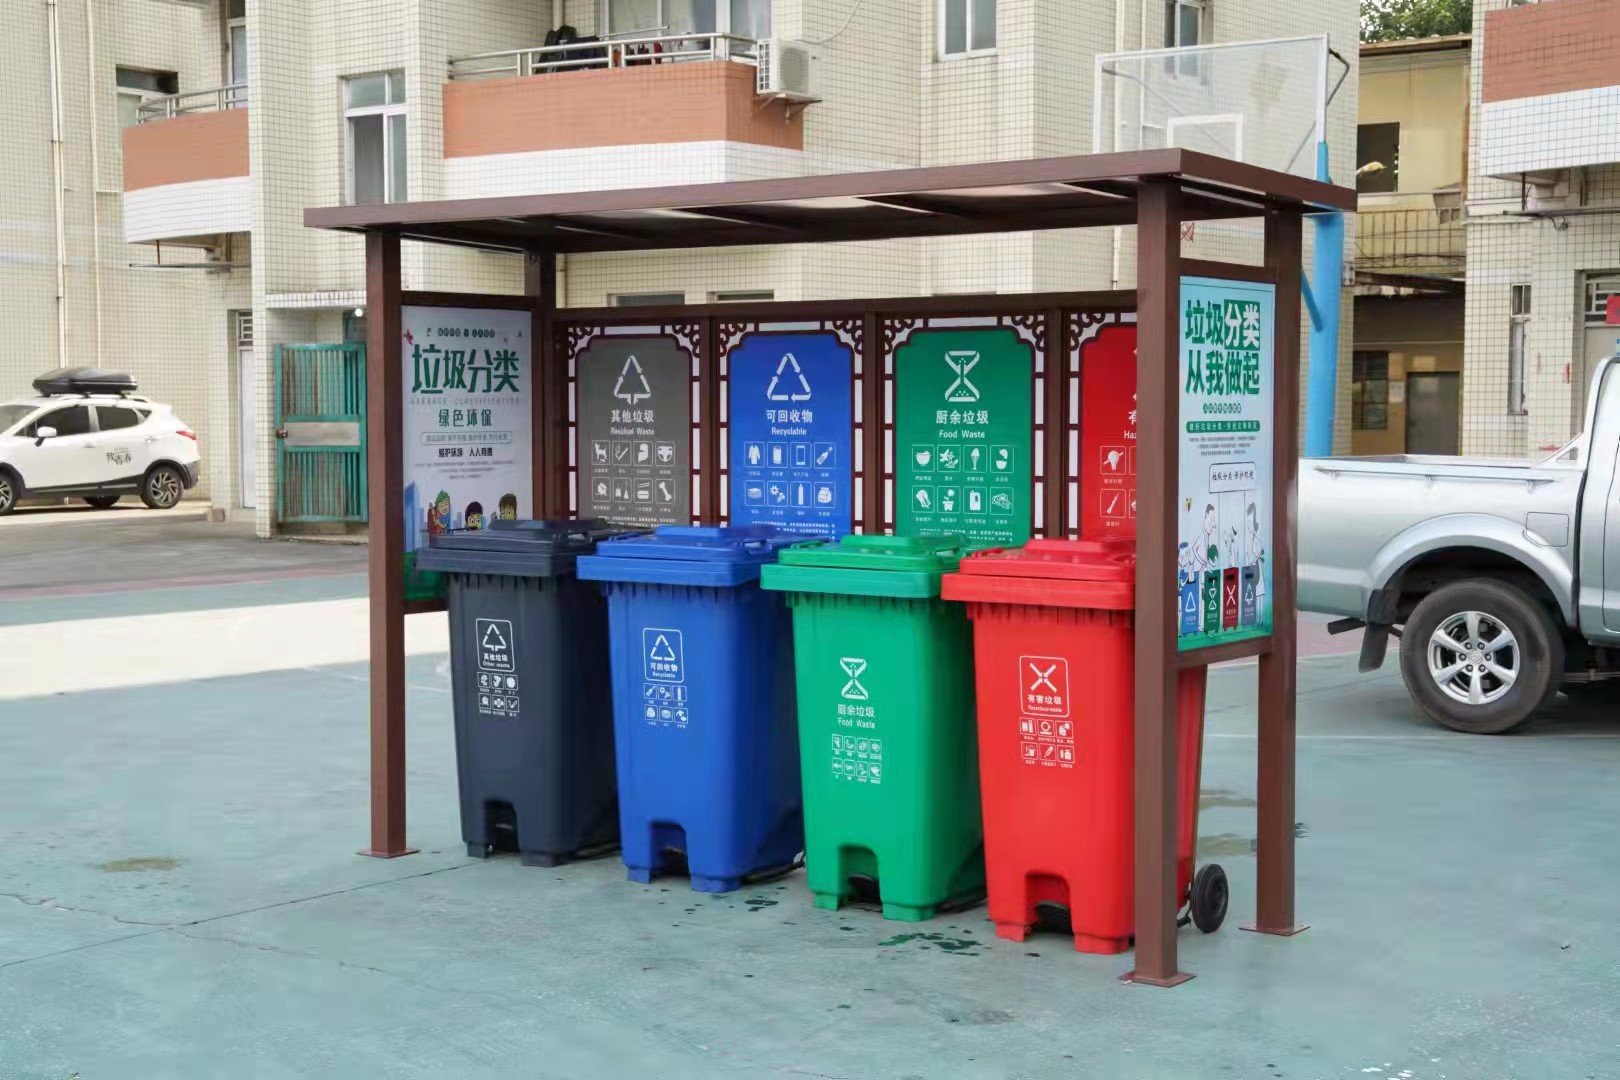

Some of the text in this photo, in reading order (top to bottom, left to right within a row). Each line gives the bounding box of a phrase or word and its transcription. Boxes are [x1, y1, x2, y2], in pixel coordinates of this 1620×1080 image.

[1185, 300, 1259, 347] 垃圾分类
[412, 344, 519, 394] 垃圾分类
[1185, 349, 1260, 396] 从我做起
[438, 408, 492, 427] 绿色环保
[611, 408, 655, 423] 其他垃圾
[766, 409, 813, 423] 可回收物
[936, 410, 989, 425] 厨余垃圾
[611, 427, 655, 436] Residual Waste
[771, 427, 807, 436] Recyclable
[939, 429, 985, 439] Food Waste
[483, 653, 508, 662] 其他垃圾
[650, 662, 678, 673] 可回收物
[1028, 694, 1062, 705] 有害垃圾
[837, 703, 875, 718] 厨余垃圾
[837, 717, 875, 729] Food Waste
